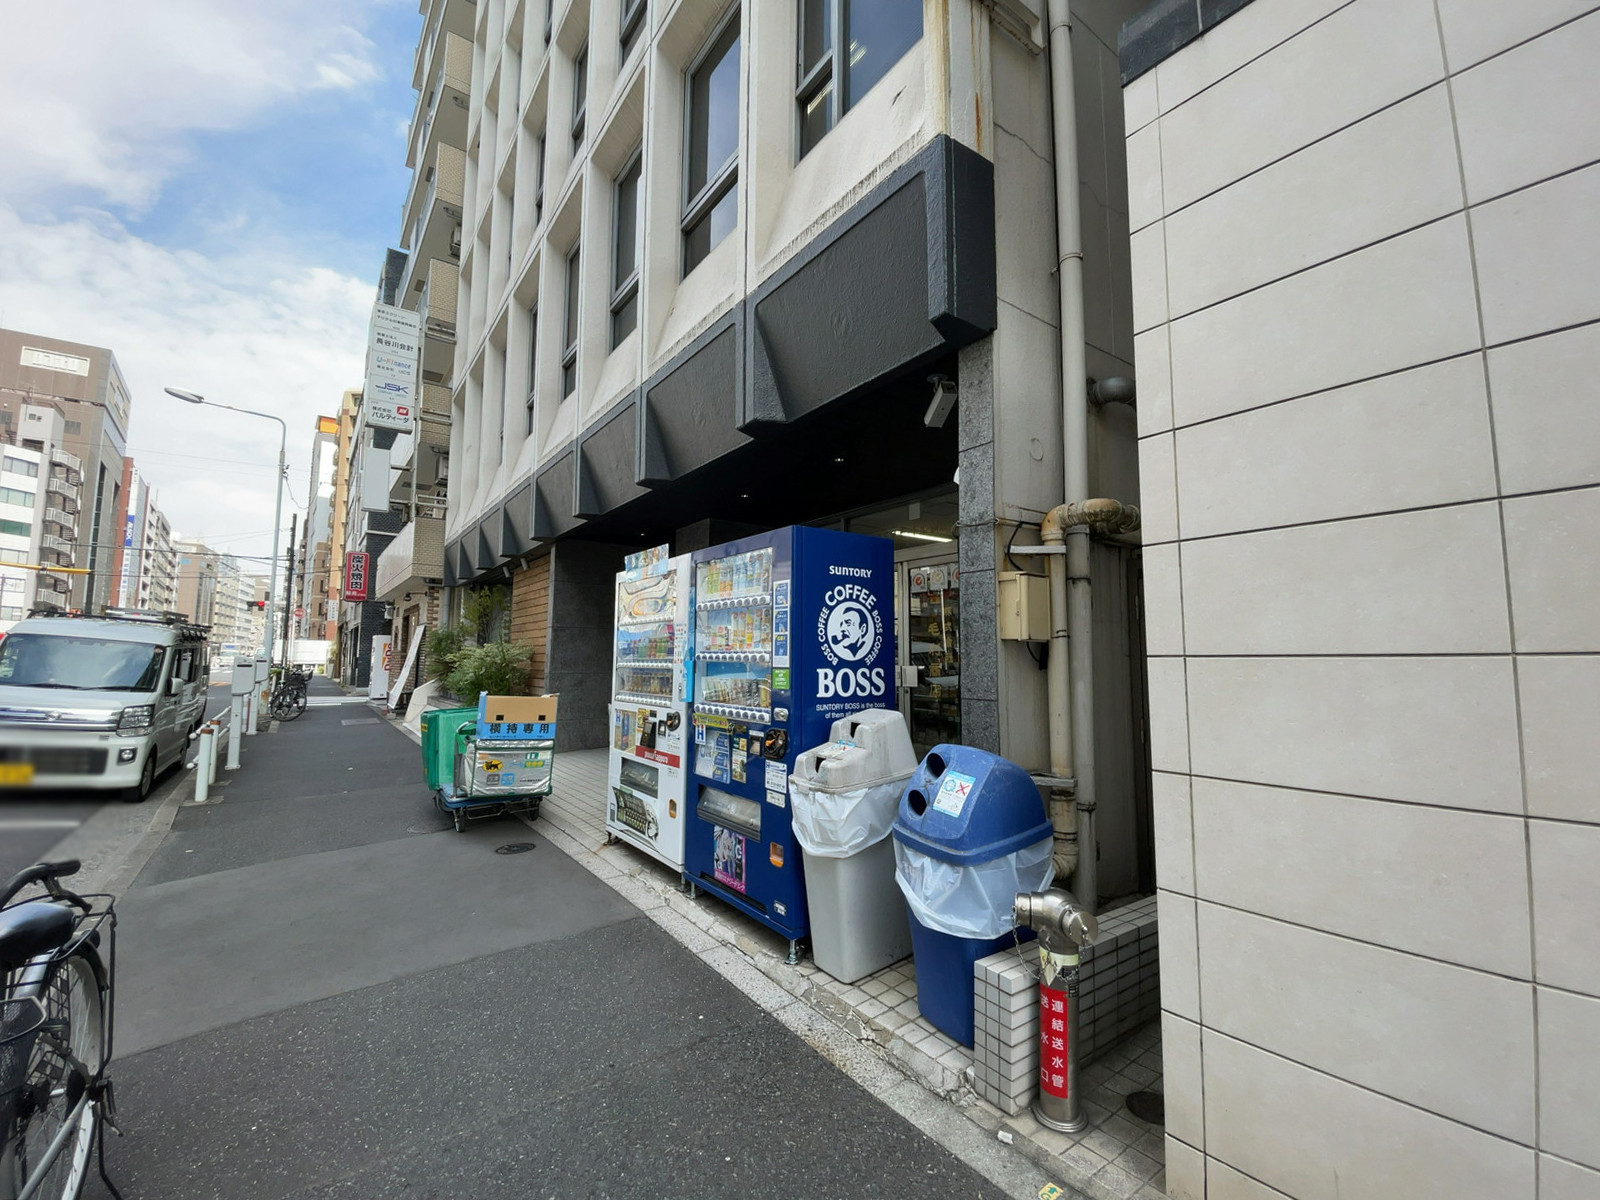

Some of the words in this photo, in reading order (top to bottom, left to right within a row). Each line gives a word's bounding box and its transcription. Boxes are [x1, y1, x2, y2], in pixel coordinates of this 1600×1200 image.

[376, 337, 414, 352] 長谷川会計
[375, 382, 409, 394] JSK
[350, 555, 364, 589] 炭火焼肉
[829, 565, 872, 579] SUNTORY
[825, 584, 877, 610] COFFEE
[818, 606, 830, 642] COFFEE
[872, 609, 883, 634] BOSS
[821, 643, 839, 666] BOSS
[865, 635, 883, 666] COFFEE
[816, 667, 886, 698] BOSS
[816, 703, 844, 711] SUNTORY
[1040, 994, 1049, 1082] 送水口
[1051, 999, 1064, 1088] 連結送水管
